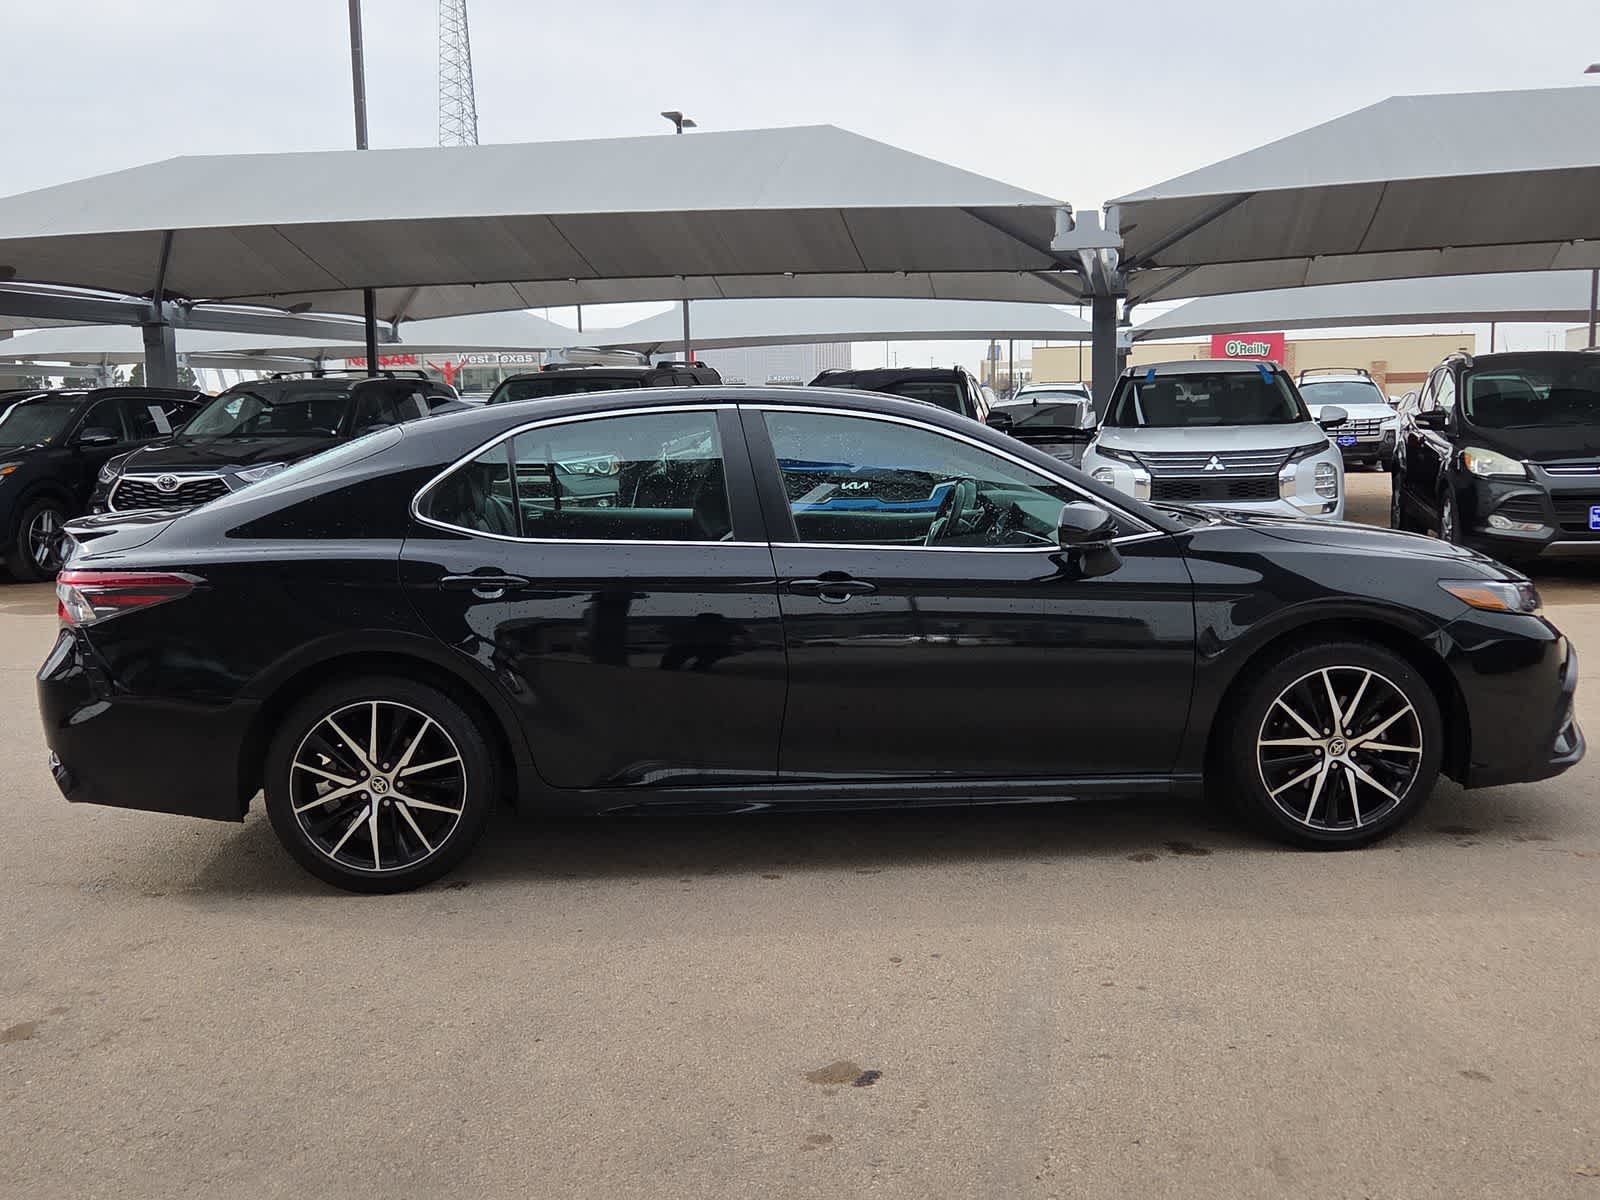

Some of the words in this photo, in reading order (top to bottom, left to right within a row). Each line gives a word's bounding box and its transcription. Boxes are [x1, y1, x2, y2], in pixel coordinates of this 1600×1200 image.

[1225, 340, 1271, 356] O'Reilly
[348, 355, 417, 366] NISAN
[457, 352, 489, 364] West
[495, 352, 533, 363] Texas
[841, 481, 869, 490] KIA
